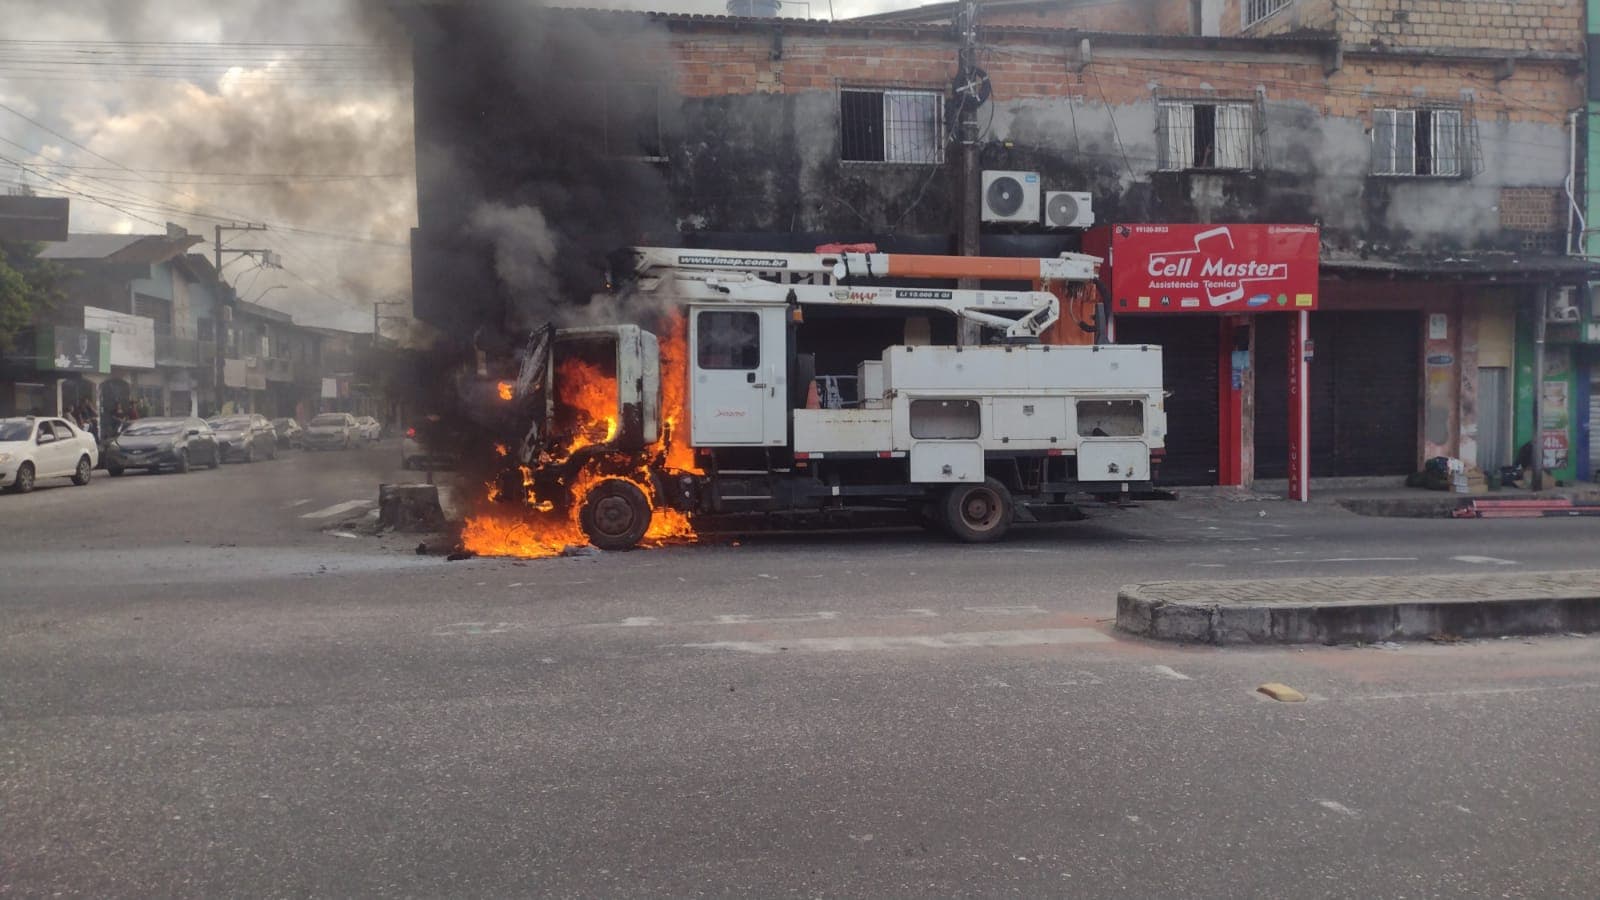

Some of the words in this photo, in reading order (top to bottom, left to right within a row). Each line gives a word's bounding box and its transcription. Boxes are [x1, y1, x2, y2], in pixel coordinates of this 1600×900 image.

[680, 257, 786, 267] www.imap.com.br
[1148, 257, 1191, 276] Cell
[1200, 258, 1280, 276] Master
